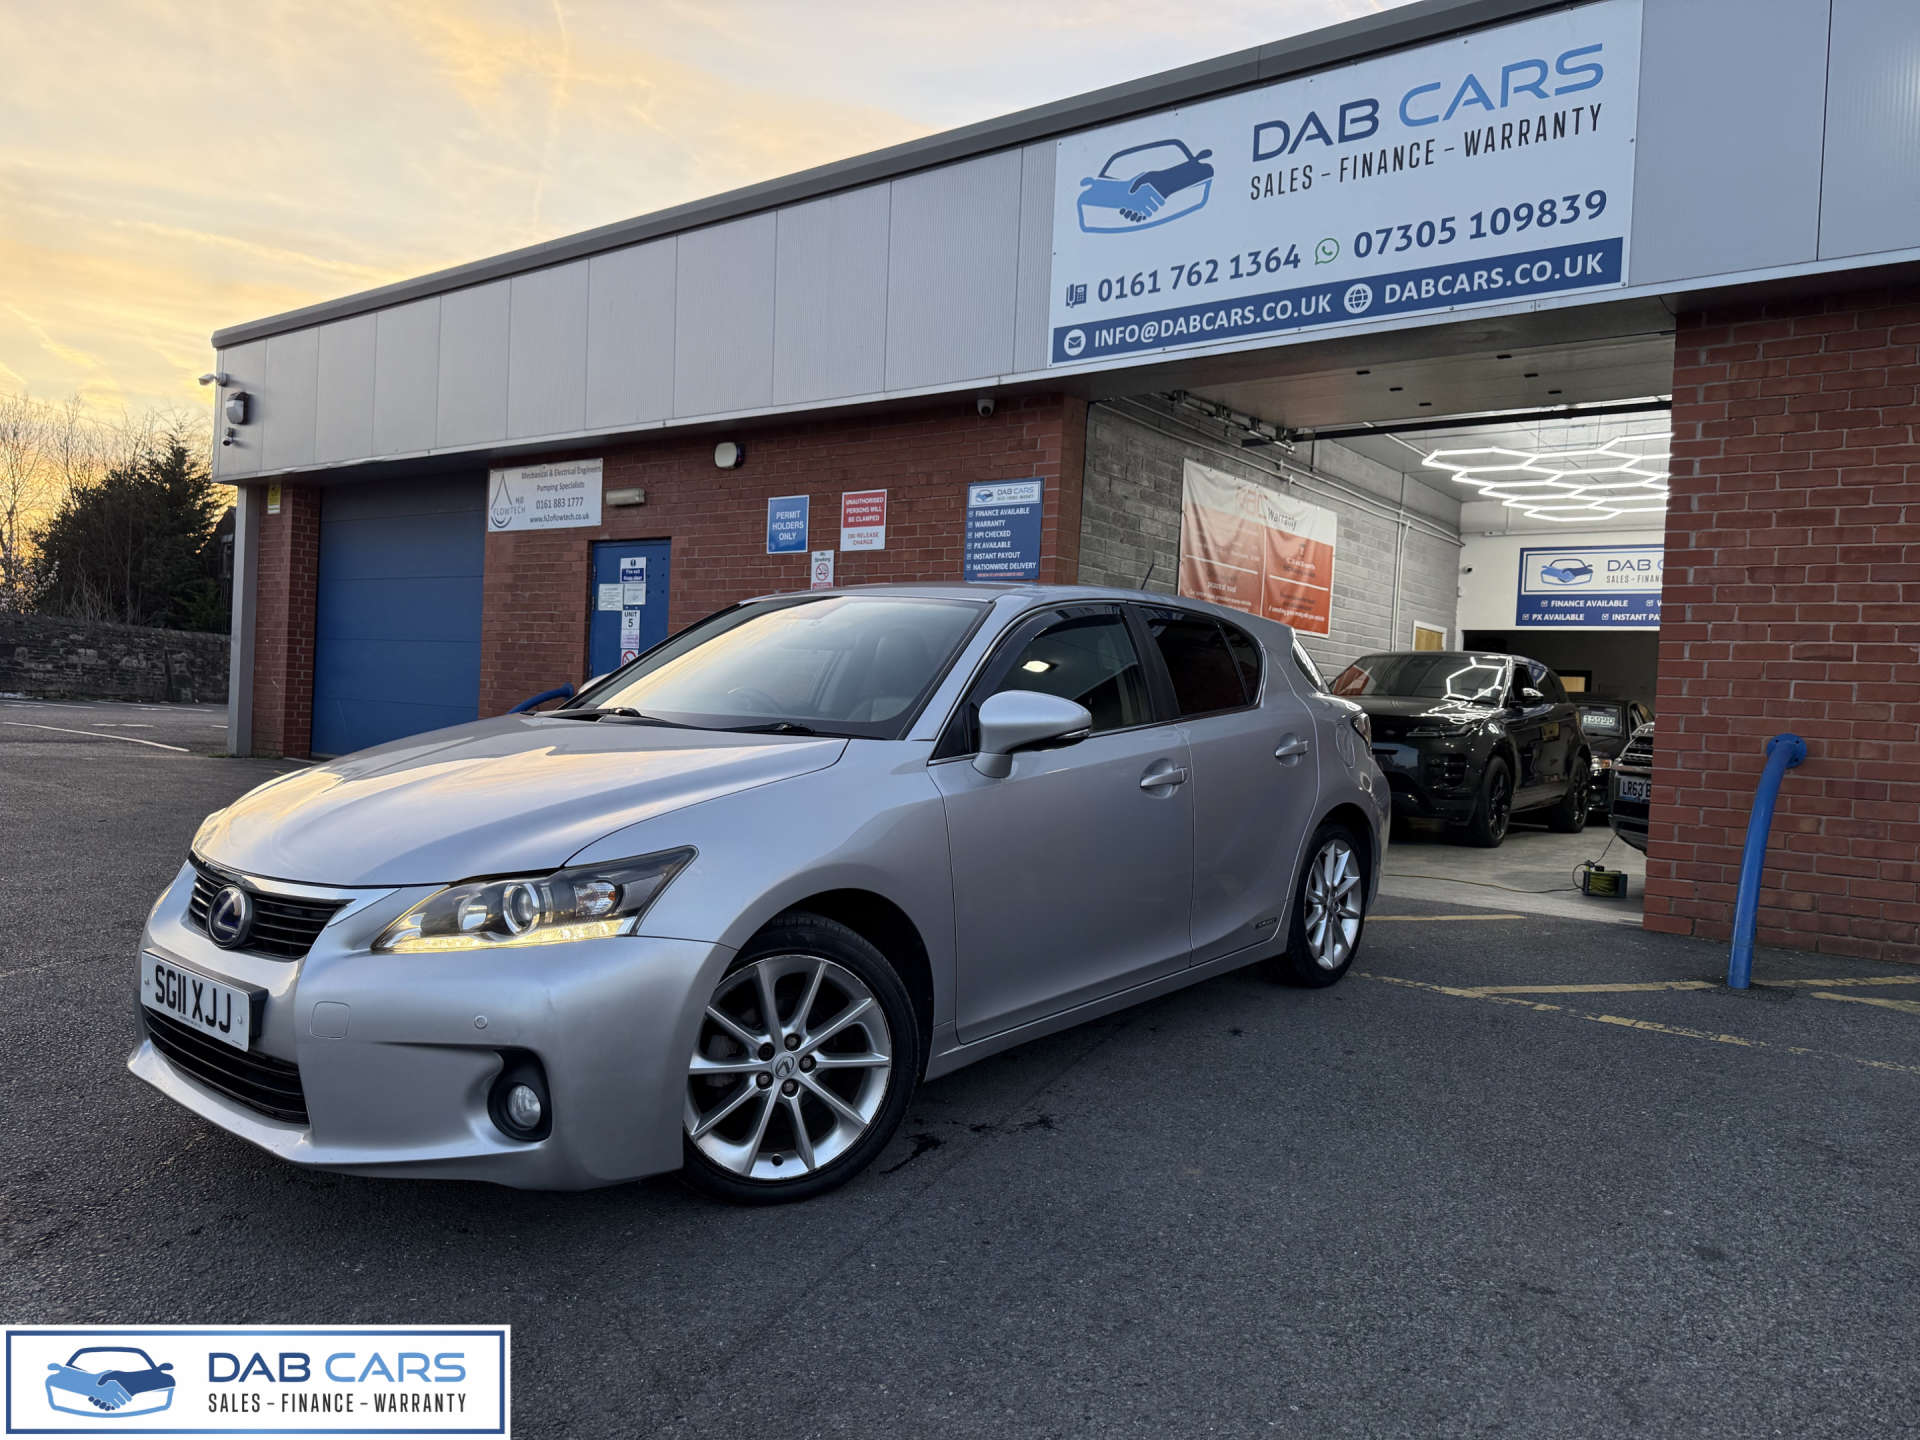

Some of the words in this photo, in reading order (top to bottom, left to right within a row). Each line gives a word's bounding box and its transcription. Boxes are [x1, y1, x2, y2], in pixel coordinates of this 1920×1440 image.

[1252, 98, 1379, 163] DAB
[1399, 43, 1604, 127] CARS
[1250, 165, 1313, 200] SALES
[1339, 139, 1436, 182] FINANCE
[1463, 103, 1602, 157] WARRANTY
[1097, 270, 1161, 302] 0161
[1170, 259, 1218, 290] 762
[1229, 244, 1301, 280] 1364
[1353, 216, 1457, 258] 07305
[1469, 189, 1607, 240] 109839
[1094, 293, 1332, 348] INFO@DABCARS.CO.UK
[1384, 252, 1604, 304] DABCARS.CO.UK
[537, 484, 558, 492] Pumping
[559, 481, 585, 491] Specialists
[997, 488, 1013, 496] DAB
[1013, 486, 1034, 495] CARS
[536, 499, 552, 510] 0161
[553, 498, 565, 509] 883
[567, 497, 584, 507] 1777
[870, 505, 882, 513] WILL
[975, 509, 999, 517] FINANCE
[1000, 507, 1030, 515] AVAILABLE
[776, 510, 801, 520] PERMIT
[856, 515, 880, 523] CLAMPED
[1267, 508, 1297, 530] Warranty
[772, 521, 804, 530] HOLDERS
[974, 519, 1006, 528] WARRANTY
[778, 532, 796, 541] ONLY
[974, 531, 984, 539] HPI
[985, 530, 1011, 538] CHECKED
[981, 541, 1011, 549] AVAILABLE
[973, 552, 997, 560] INSTANT
[997, 551, 1021, 559] PAYOUT
[972, 562, 1009, 570] NATIONWIDE
[1009, 561, 1036, 569] DELIVERY
[1607, 559, 1651, 572] DAB
[1606, 575, 1629, 584] SALES
[1550, 599, 1584, 607] FINANCE
[1586, 599, 1628, 607] AVAILABLE
[1543, 613, 1584, 621] AVAILABLE
[1612, 613, 1648, 621] INSTANT
[628, 618, 634, 628] 5
[1622, 781, 1643, 797] LR63
[192, 979, 231, 1033] XJJ
